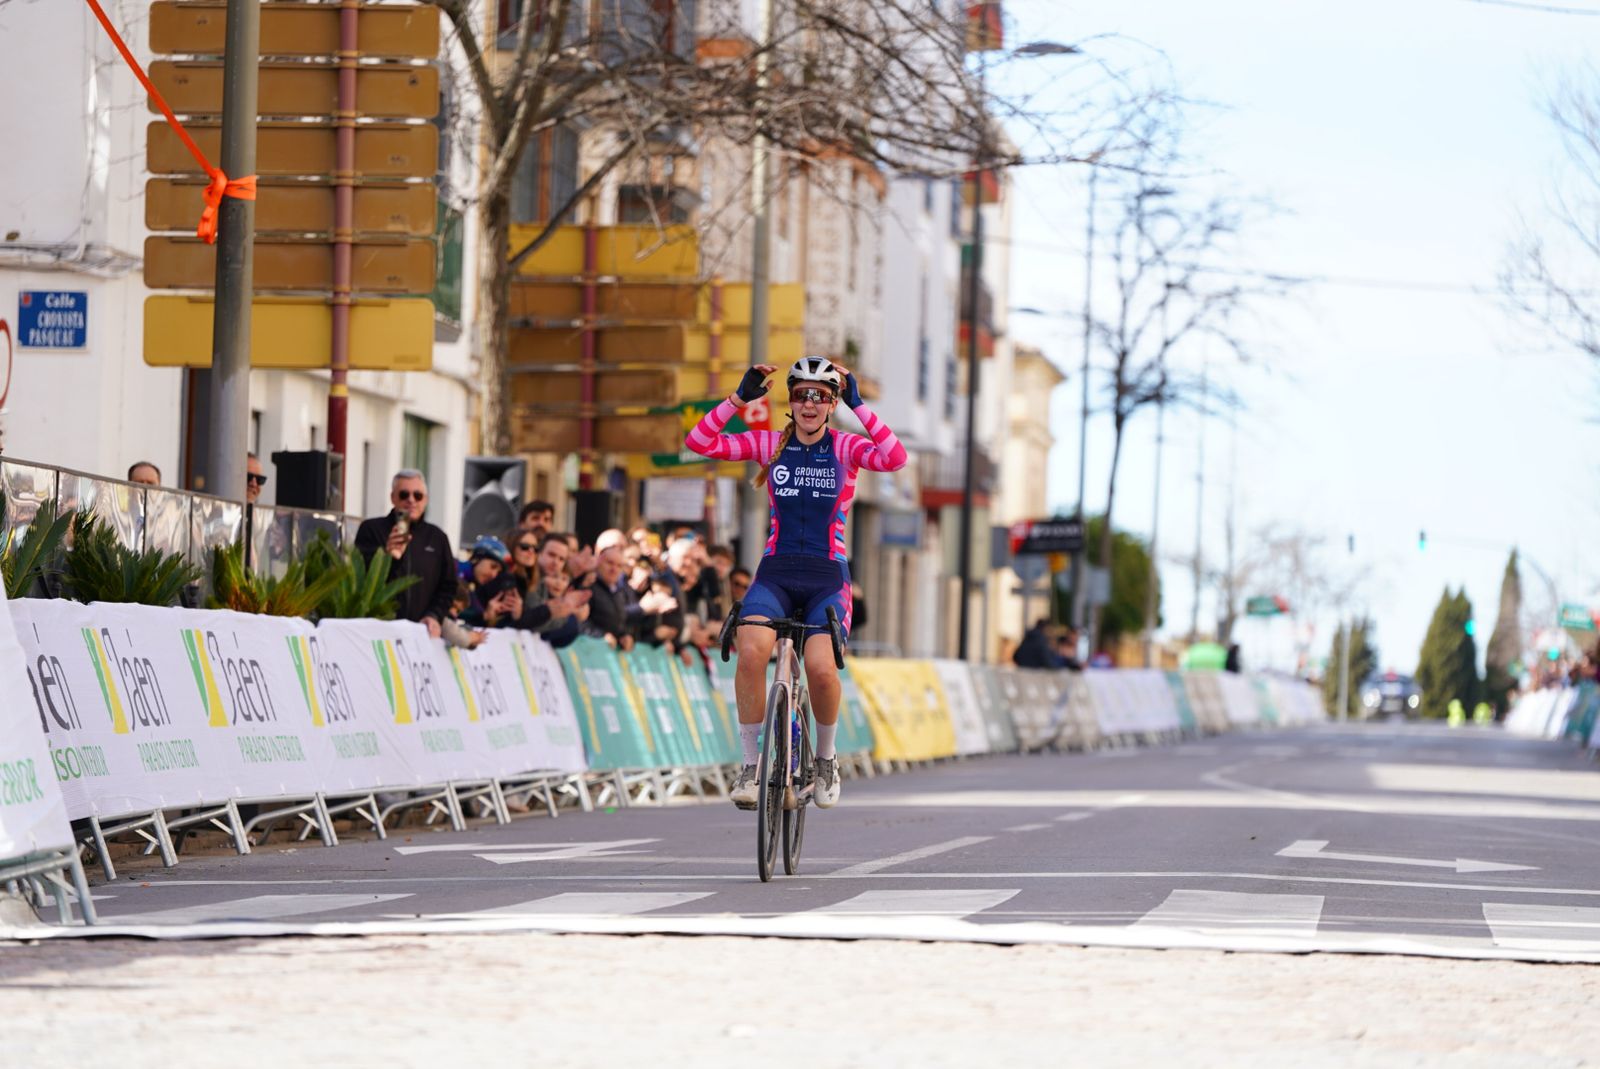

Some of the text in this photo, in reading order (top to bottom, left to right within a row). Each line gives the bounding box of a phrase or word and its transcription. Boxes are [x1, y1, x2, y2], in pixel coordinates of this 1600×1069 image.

[795, 466, 836, 478] GROUWELS
[794, 477, 836, 489] VASTGOED
[774, 488, 800, 497] LAZER
